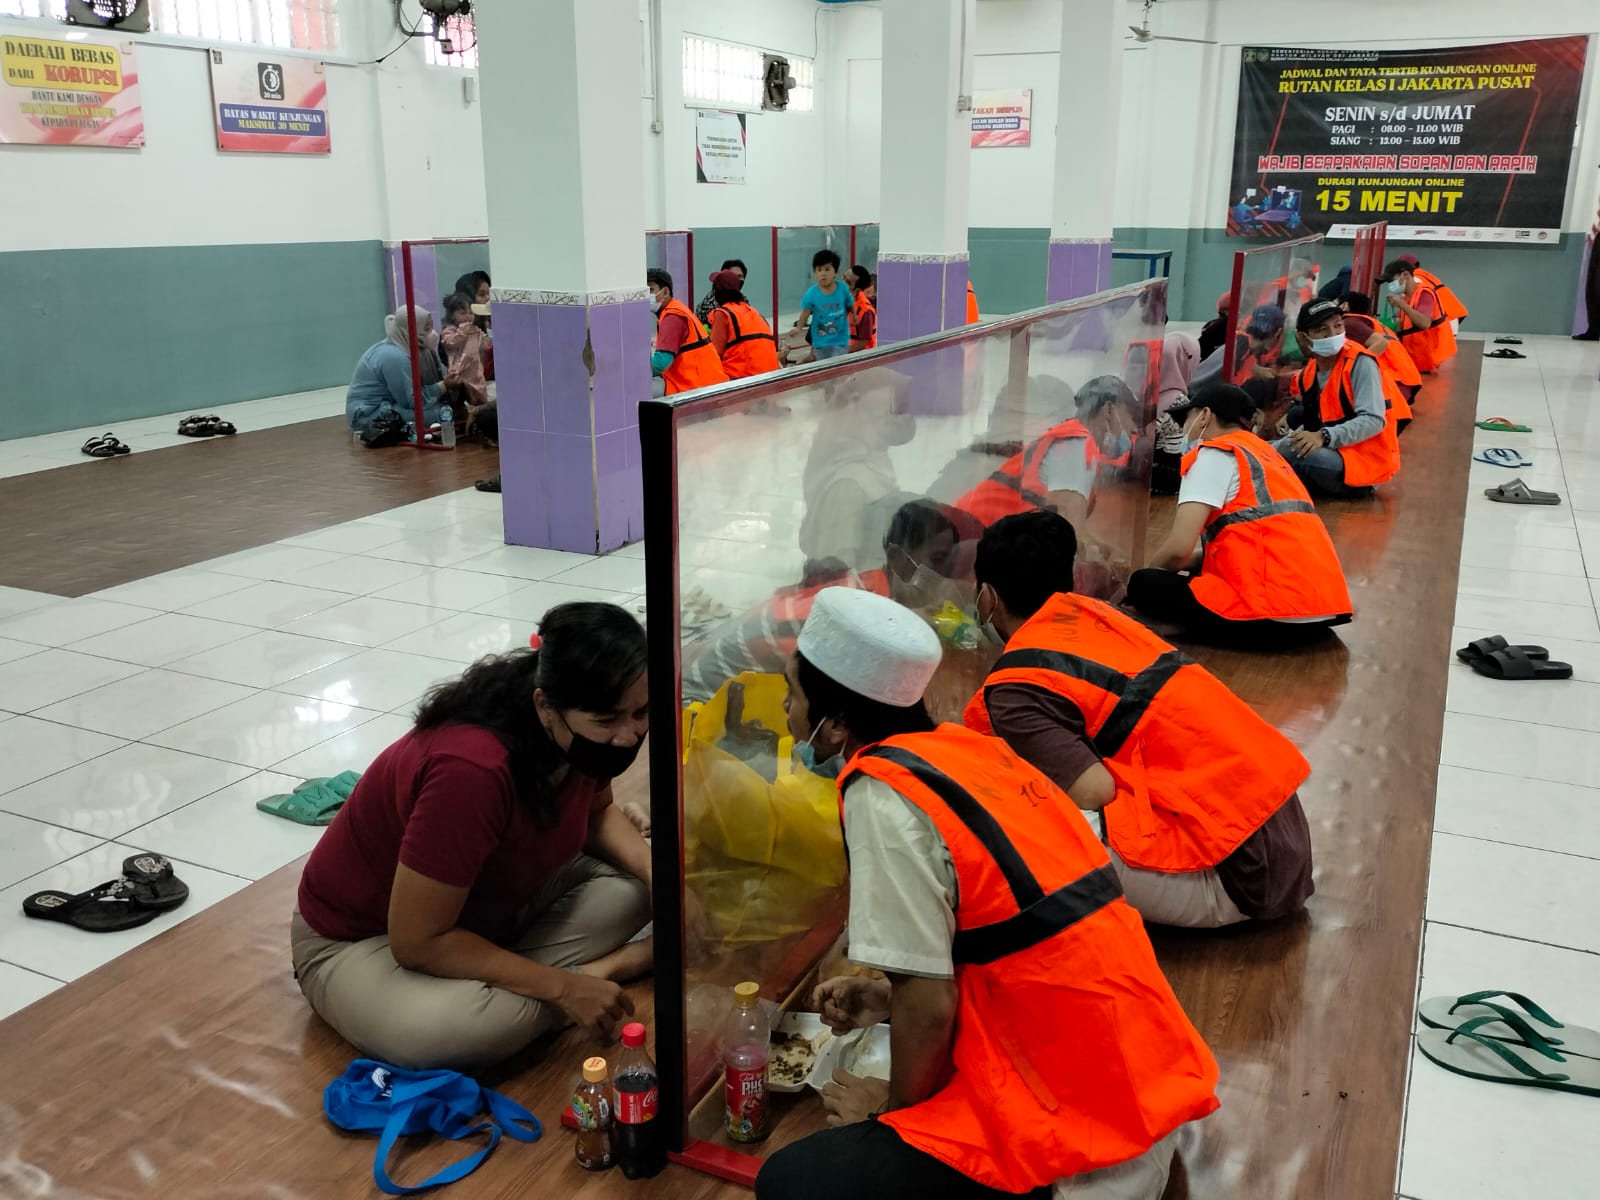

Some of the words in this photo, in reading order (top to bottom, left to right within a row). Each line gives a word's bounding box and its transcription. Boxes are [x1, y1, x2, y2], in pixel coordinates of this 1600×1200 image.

[5, 41, 65, 60] DAERAH
[71, 48, 114, 64] BEBAS
[8, 68, 34, 79] DARI
[44, 64, 118, 86] KORUPSI
[1280, 69, 1323, 79] JADWAL
[1324, 68, 1348, 77] DAN
[1349, 68, 1376, 76] TATA
[1378, 66, 1418, 76] TERTIB
[1420, 64, 1492, 75] KUNJUNGAN
[1493, 63, 1537, 73] ONLINE
[1279, 80, 1331, 93] RUTAN
[1334, 79, 1386, 92] KELAS
[1389, 79, 1395, 91] I
[1397, 77, 1474, 91] JAKARTA
[1477, 75, 1535, 89] PUSAT
[224, 109, 249, 119] BATAS
[250, 111, 277, 120] WAKTU
[1325, 106, 1376, 122] SENIN
[1380, 106, 1407, 123] s/d
[1412, 104, 1476, 120] JUMAT
[1332, 125, 1355, 134] PAGI
[1416, 124, 1438, 133] 11.00
[1441, 123, 1464, 133] WIB
[1330, 136, 1361, 145] SIANG
[1379, 136, 1402, 145] 13.00
[1412, 136, 1435, 145] 15.00
[1438, 135, 1461, 145] WIB
[1258, 155, 1301, 170] WAJIB
[1303, 154, 1397, 171] BERPAKAIAN
[1399, 154, 1452, 170] SOPAN
[1454, 155, 1487, 171] DAN
[1318, 178, 1355, 186] DURASI
[1357, 177, 1423, 186] KUNJUNGAN
[1425, 178, 1465, 187] ONLINE
[1316, 190, 1351, 211] 15
[1360, 190, 1463, 213] MENIT
